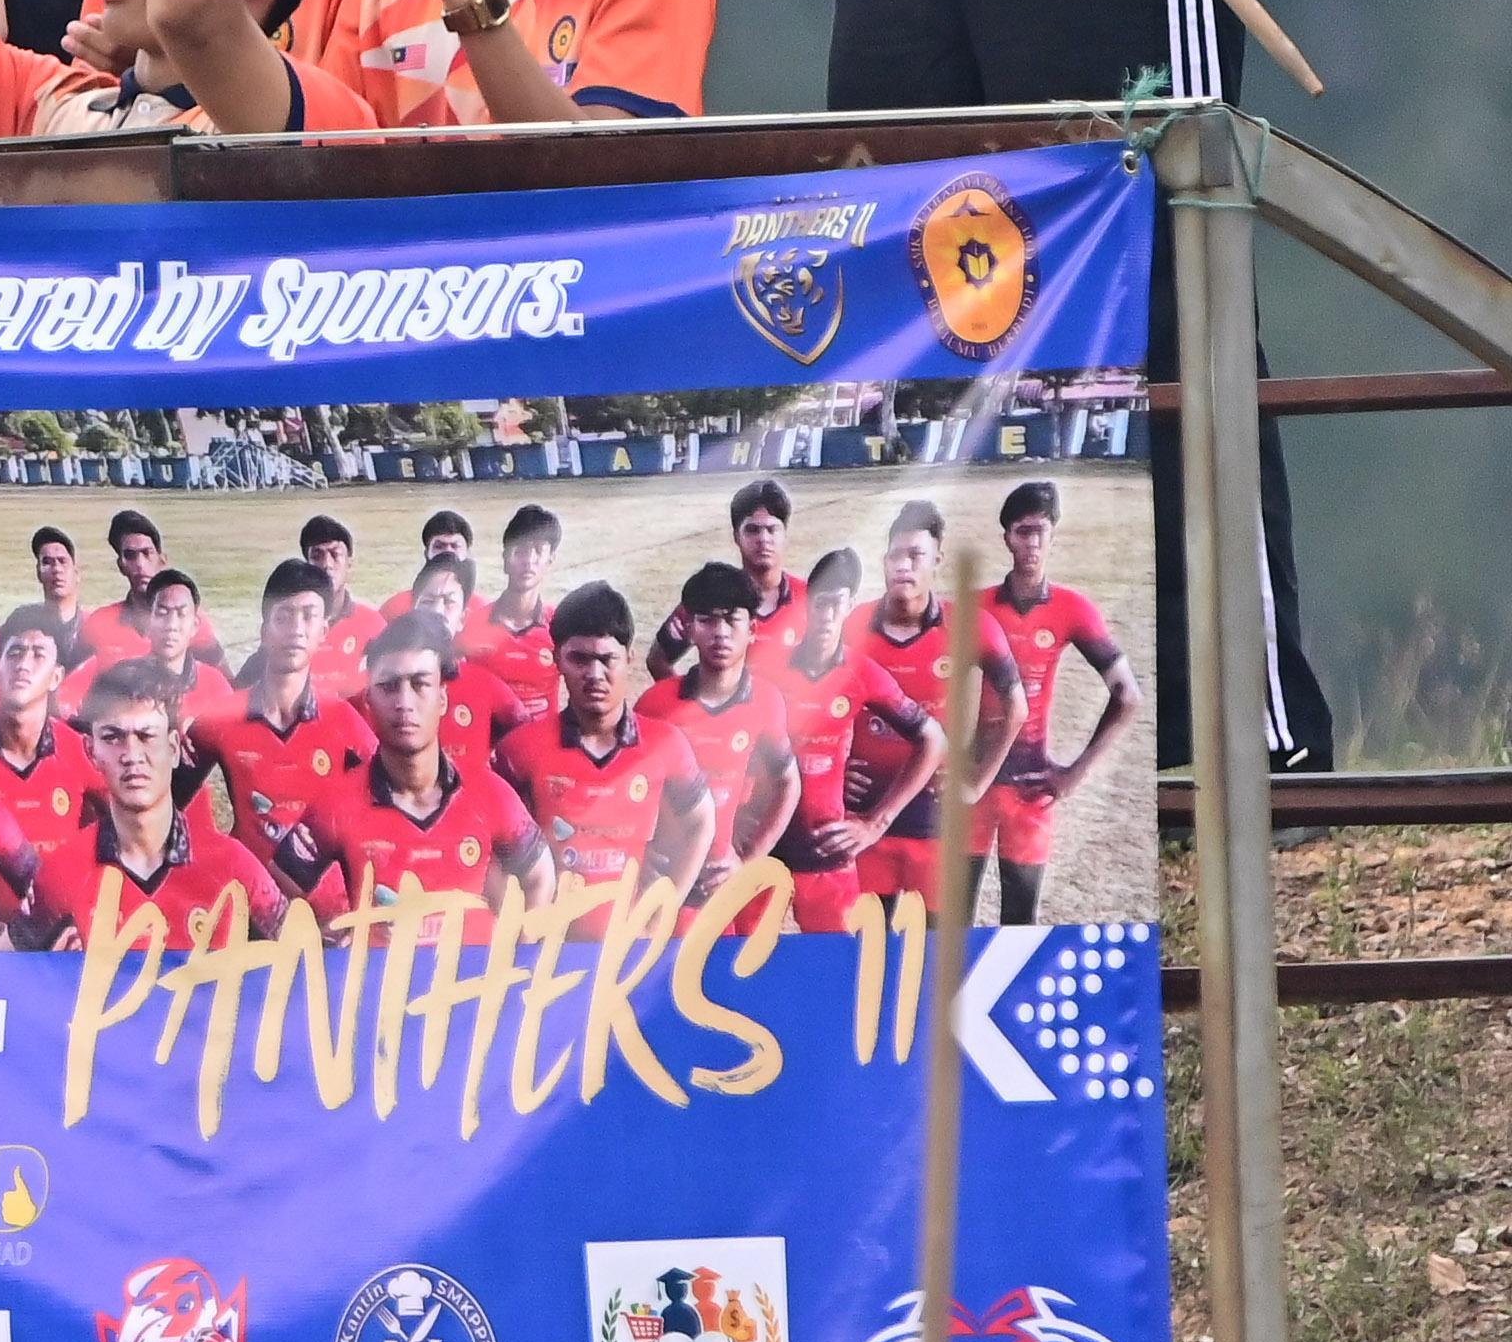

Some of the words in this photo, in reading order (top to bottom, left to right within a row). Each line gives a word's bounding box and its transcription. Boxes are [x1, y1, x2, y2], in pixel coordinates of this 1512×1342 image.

[132, 264, 247, 361] by
[240, 256, 586, 361] Sponsors.
[64, 855, 797, 1142] PANTHERS
